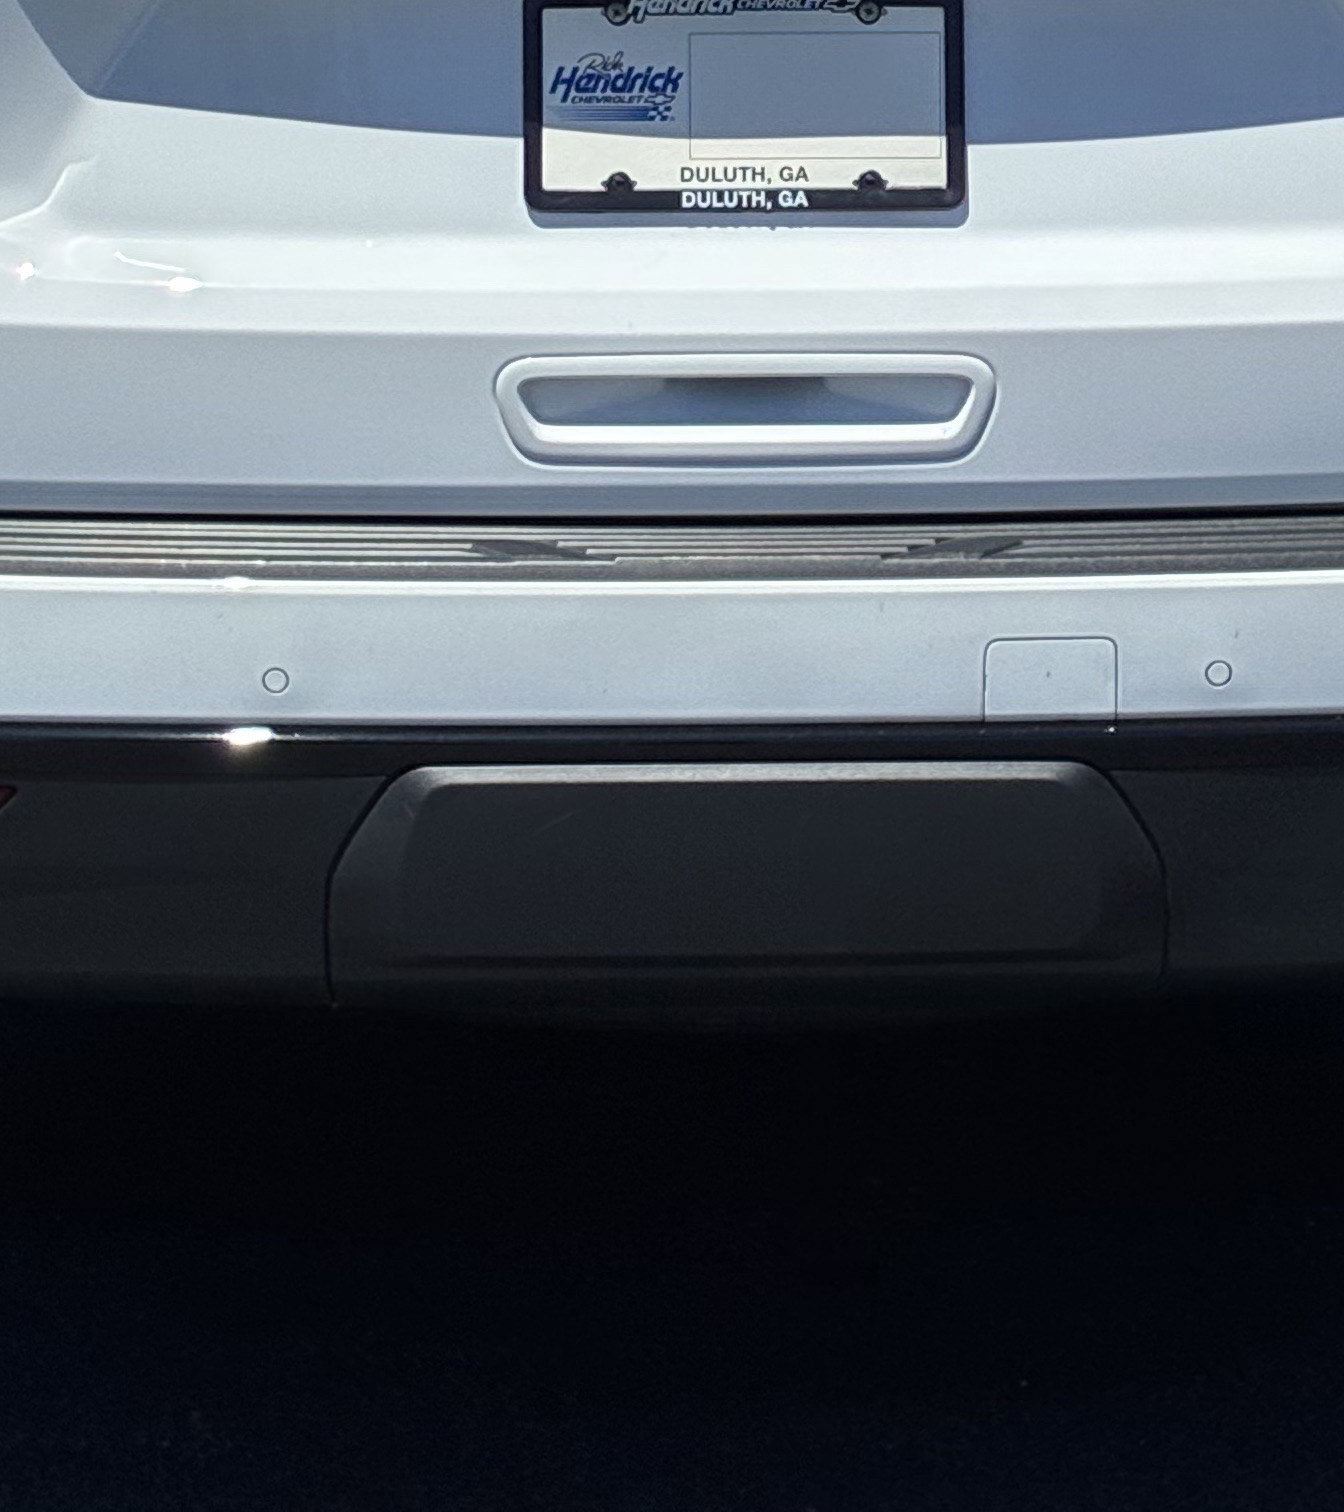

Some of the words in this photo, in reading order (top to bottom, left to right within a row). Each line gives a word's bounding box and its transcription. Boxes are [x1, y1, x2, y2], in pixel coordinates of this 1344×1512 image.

[549, 66, 684, 103] Hendrick
[571, 94, 644, 105] CHEVROLET
[680, 166, 772, 185] DULUTH,
[779, 166, 810, 183] GA
[681, 190, 772, 210] DULUTH,
[778, 190, 809, 208] GA
